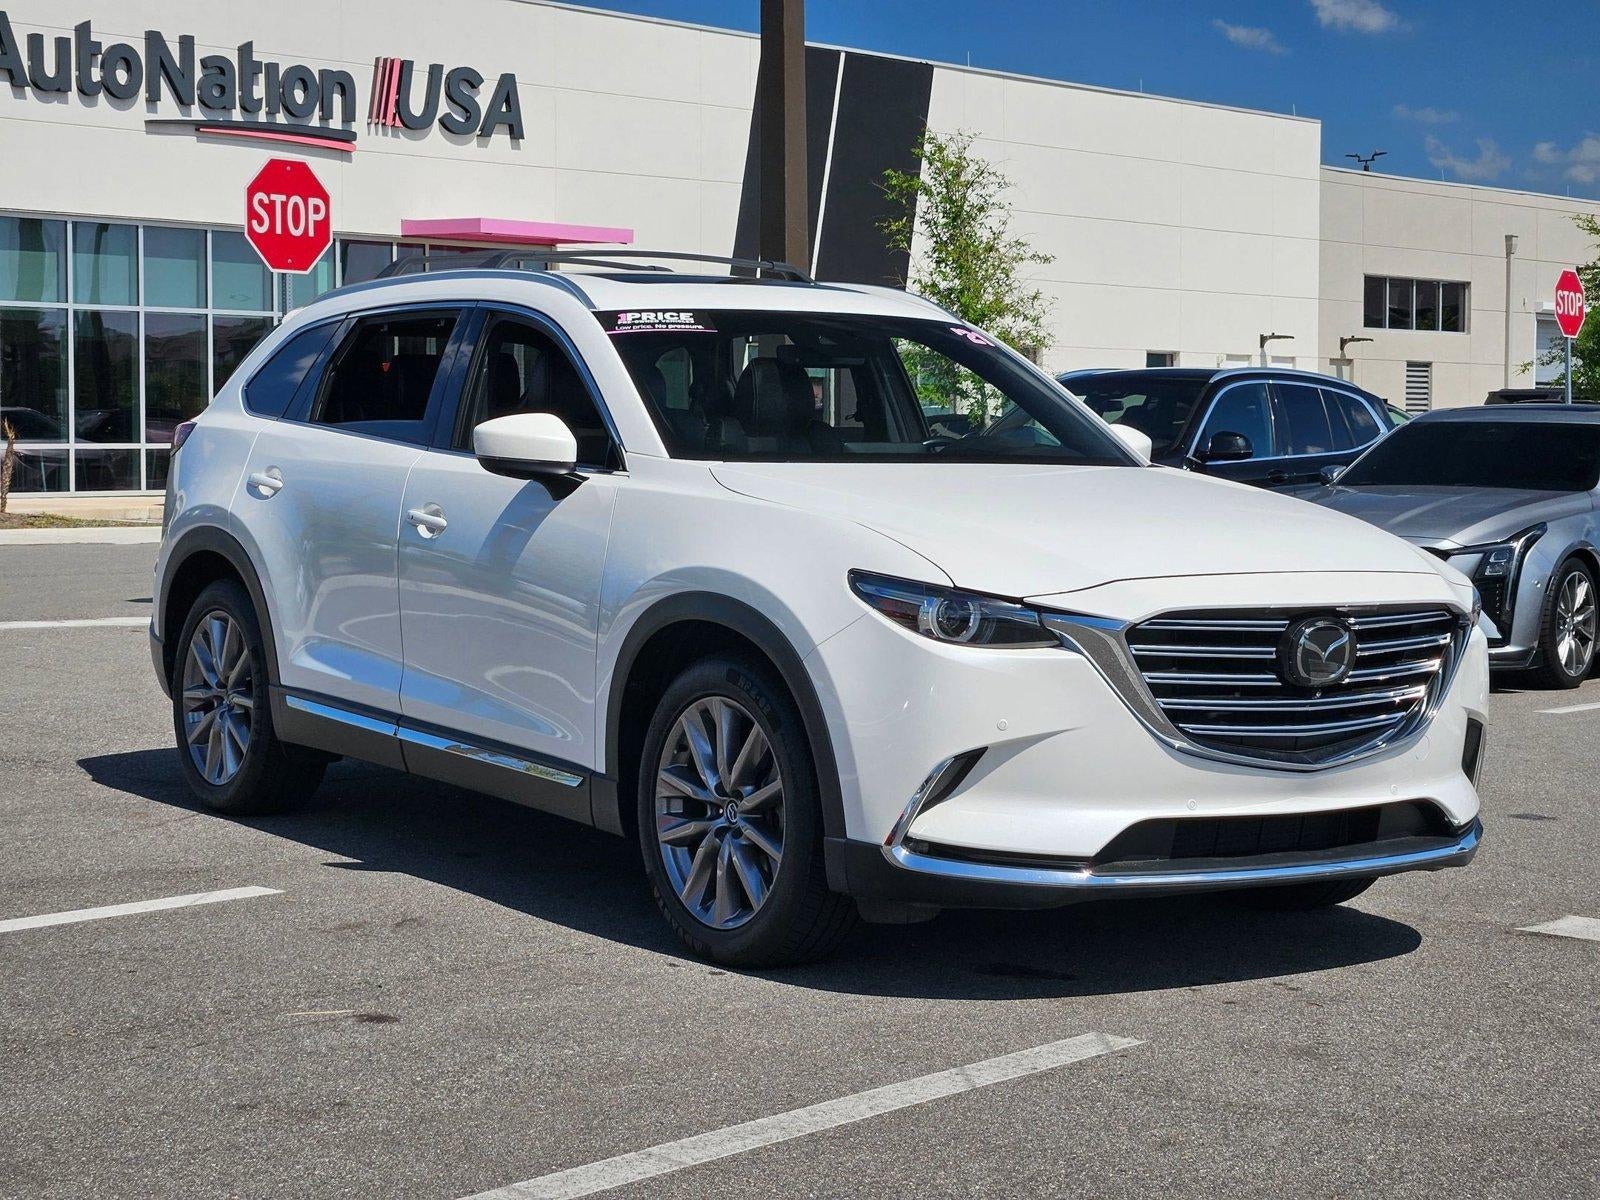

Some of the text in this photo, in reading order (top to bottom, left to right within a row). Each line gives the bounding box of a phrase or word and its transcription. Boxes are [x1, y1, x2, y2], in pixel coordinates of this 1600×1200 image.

[396, 60, 525, 140] USA
[251, 191, 326, 237] STOP
[1556, 289, 1583, 316] STOP
